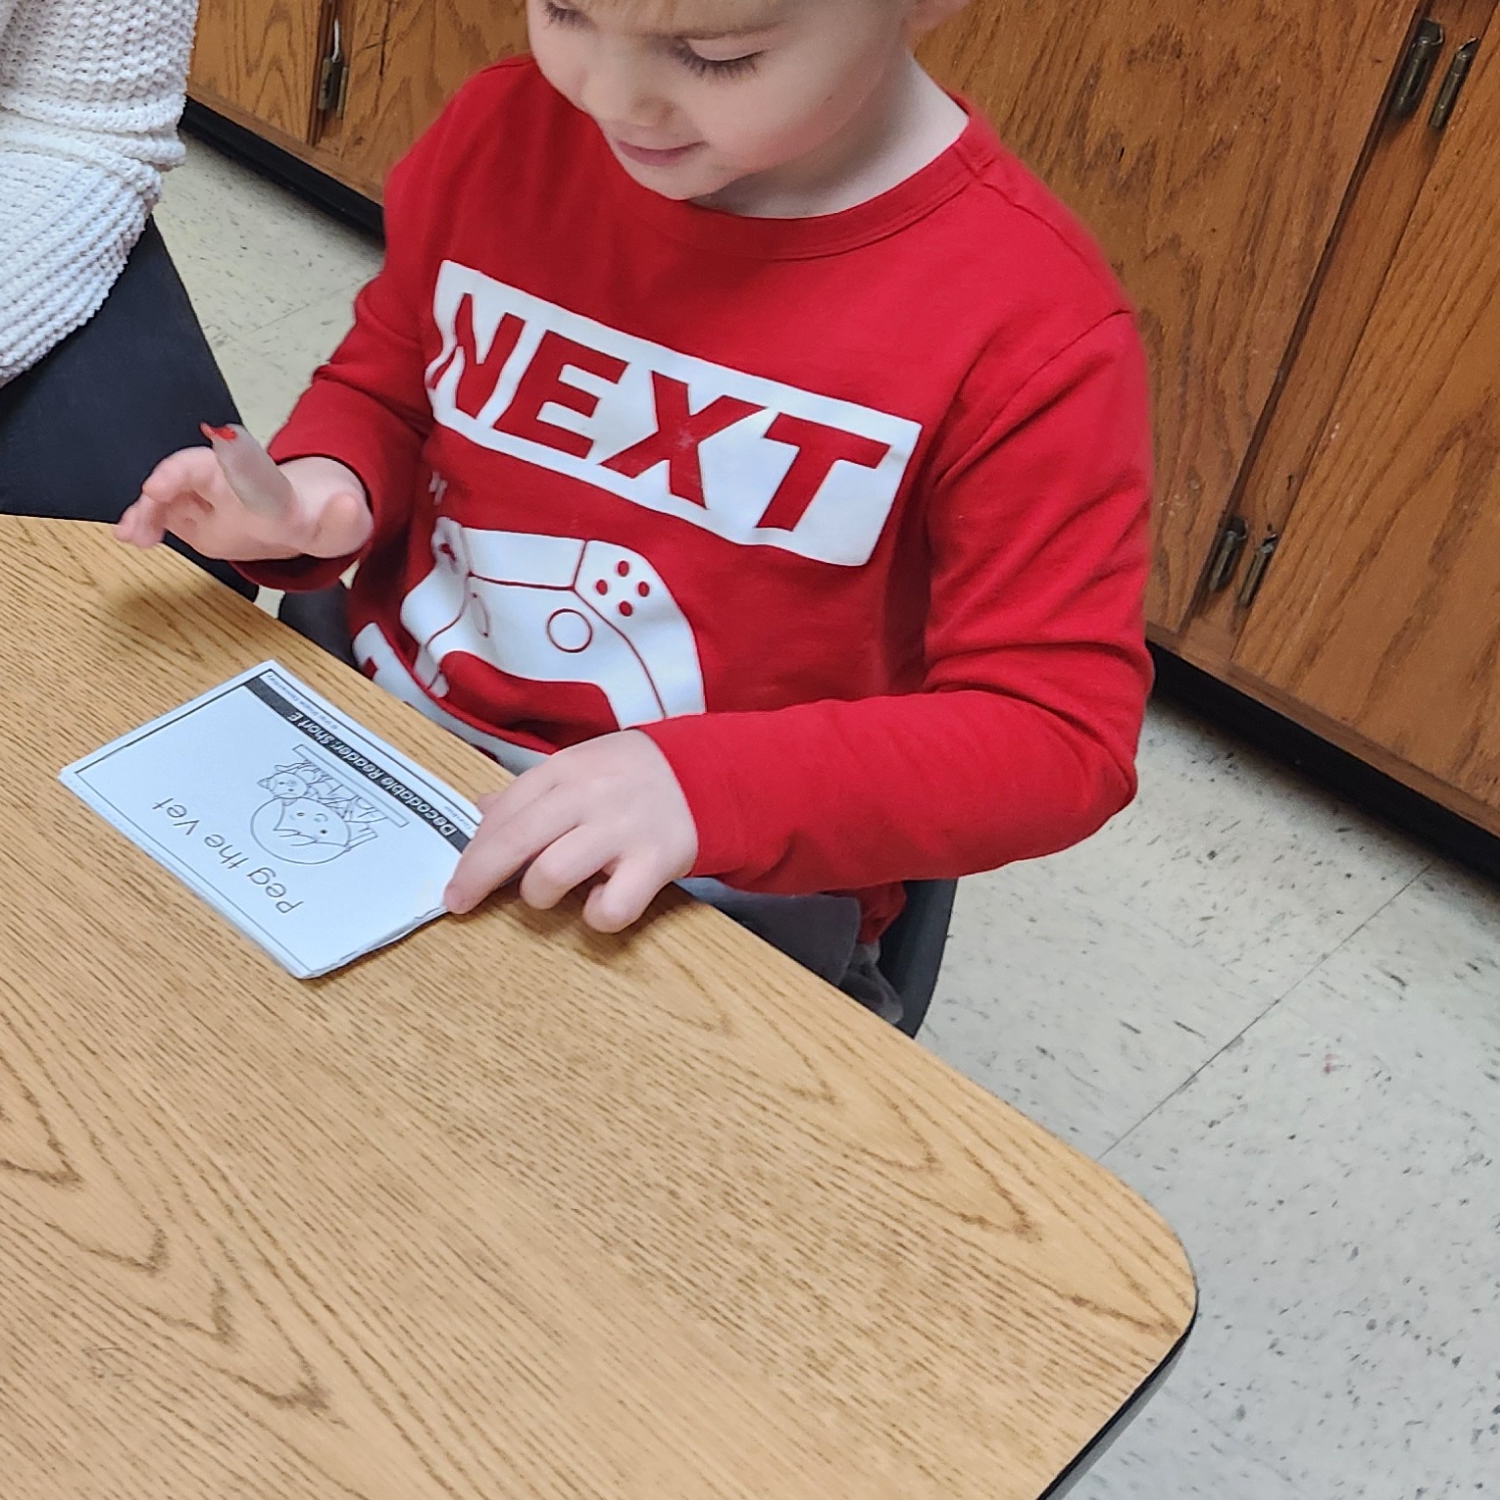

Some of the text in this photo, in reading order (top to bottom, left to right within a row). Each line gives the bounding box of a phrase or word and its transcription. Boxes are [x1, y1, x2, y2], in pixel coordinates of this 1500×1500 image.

[426, 292, 892, 532] NEXT
[287, 711, 304, 722] E
[299, 719, 333, 745] Short
[380, 776, 457, 836] Decodable
[152, 797, 304, 914] Peg the Vet
